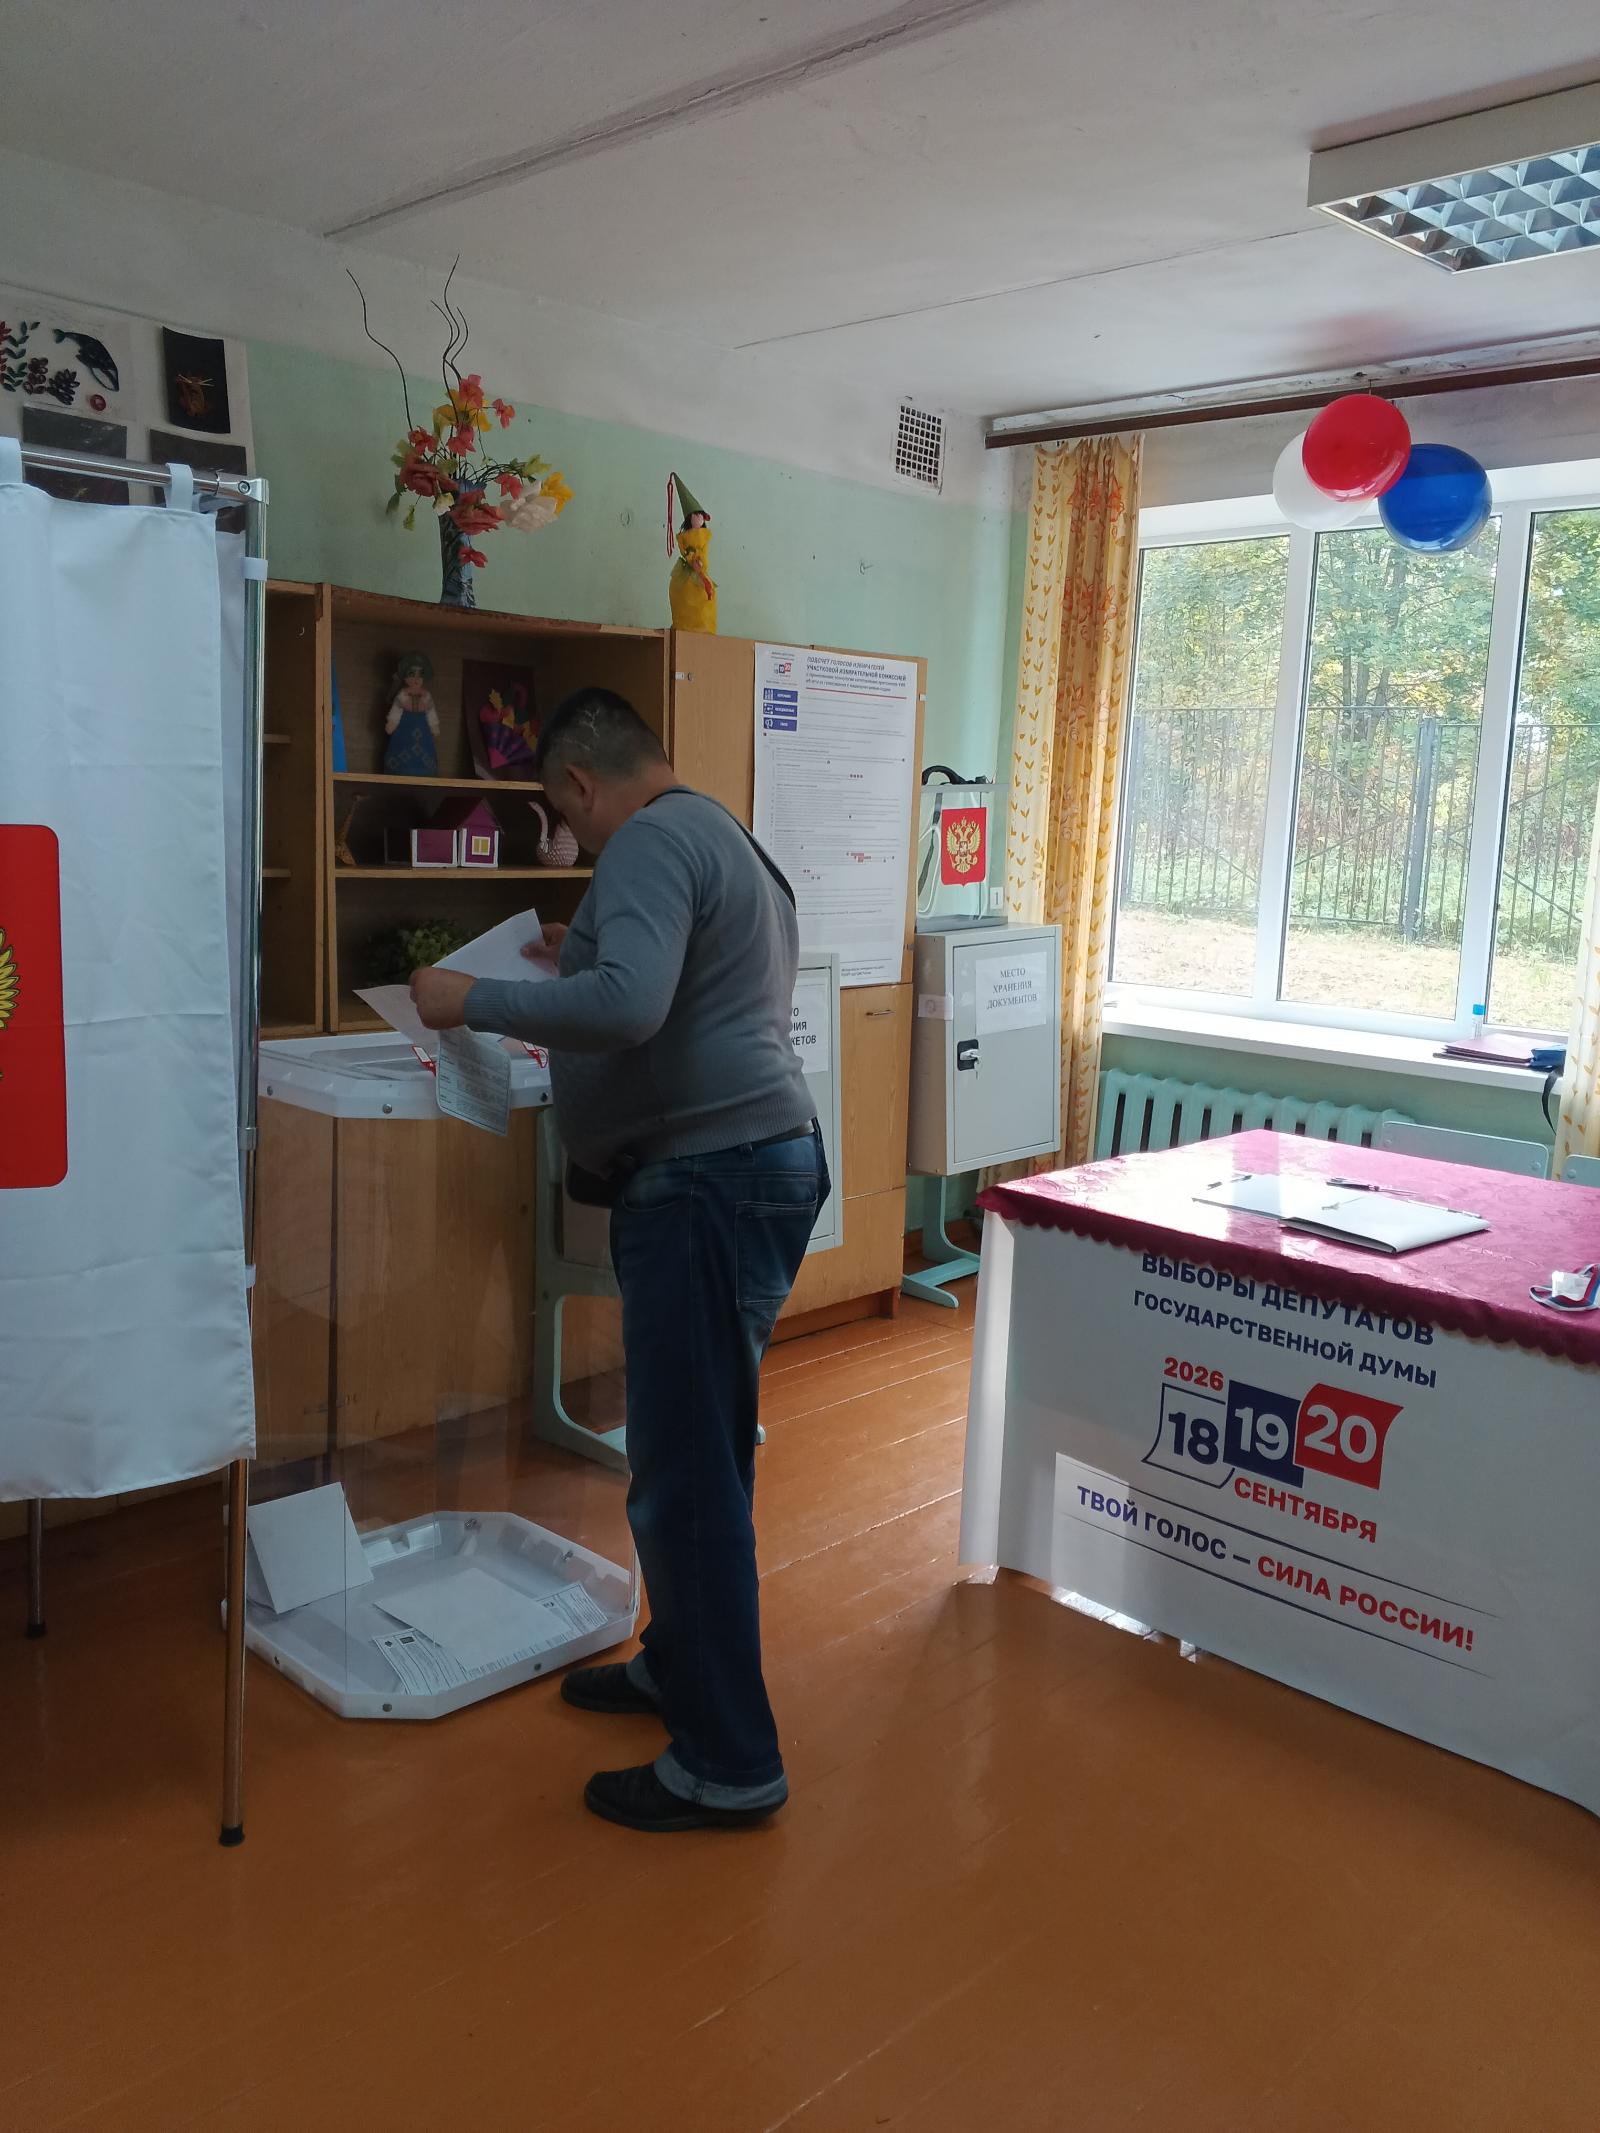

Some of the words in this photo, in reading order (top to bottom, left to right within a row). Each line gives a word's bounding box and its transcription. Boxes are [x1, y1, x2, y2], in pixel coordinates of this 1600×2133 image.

[986, 993, 1038, 1010] ДОКУМЕНТОВ
[992, 980, 1032, 994] ХРАНЕНИЯ
[1000, 968, 1026, 978] МЕСТО
[1141, 1254, 1255, 1300] ВЫБОРЫ
[1261, 1283, 1434, 1346] ДЕПУТАТОВ
[1134, 1289, 1354, 1366] ГОСУДАРСТВЕННОЙ
[1359, 1352, 1437, 1388] ДУМЫ
[1163, 1357, 1224, 1392] 2026
[1168, 1411, 1219, 1465] 18
[1234, 1406, 1289, 1461] 19
[1303, 1404, 1378, 1464] 20
[1234, 1477, 1377, 1543] СЕНТЯБРЯ
[1077, 1485, 1138, 1526] ТВОЙ
[1144, 1512, 1227, 1560] ГОЛОС
[1257, 1555, 1332, 1601] СИЛА
[1339, 1584, 1474, 1652] РОССИИ!
